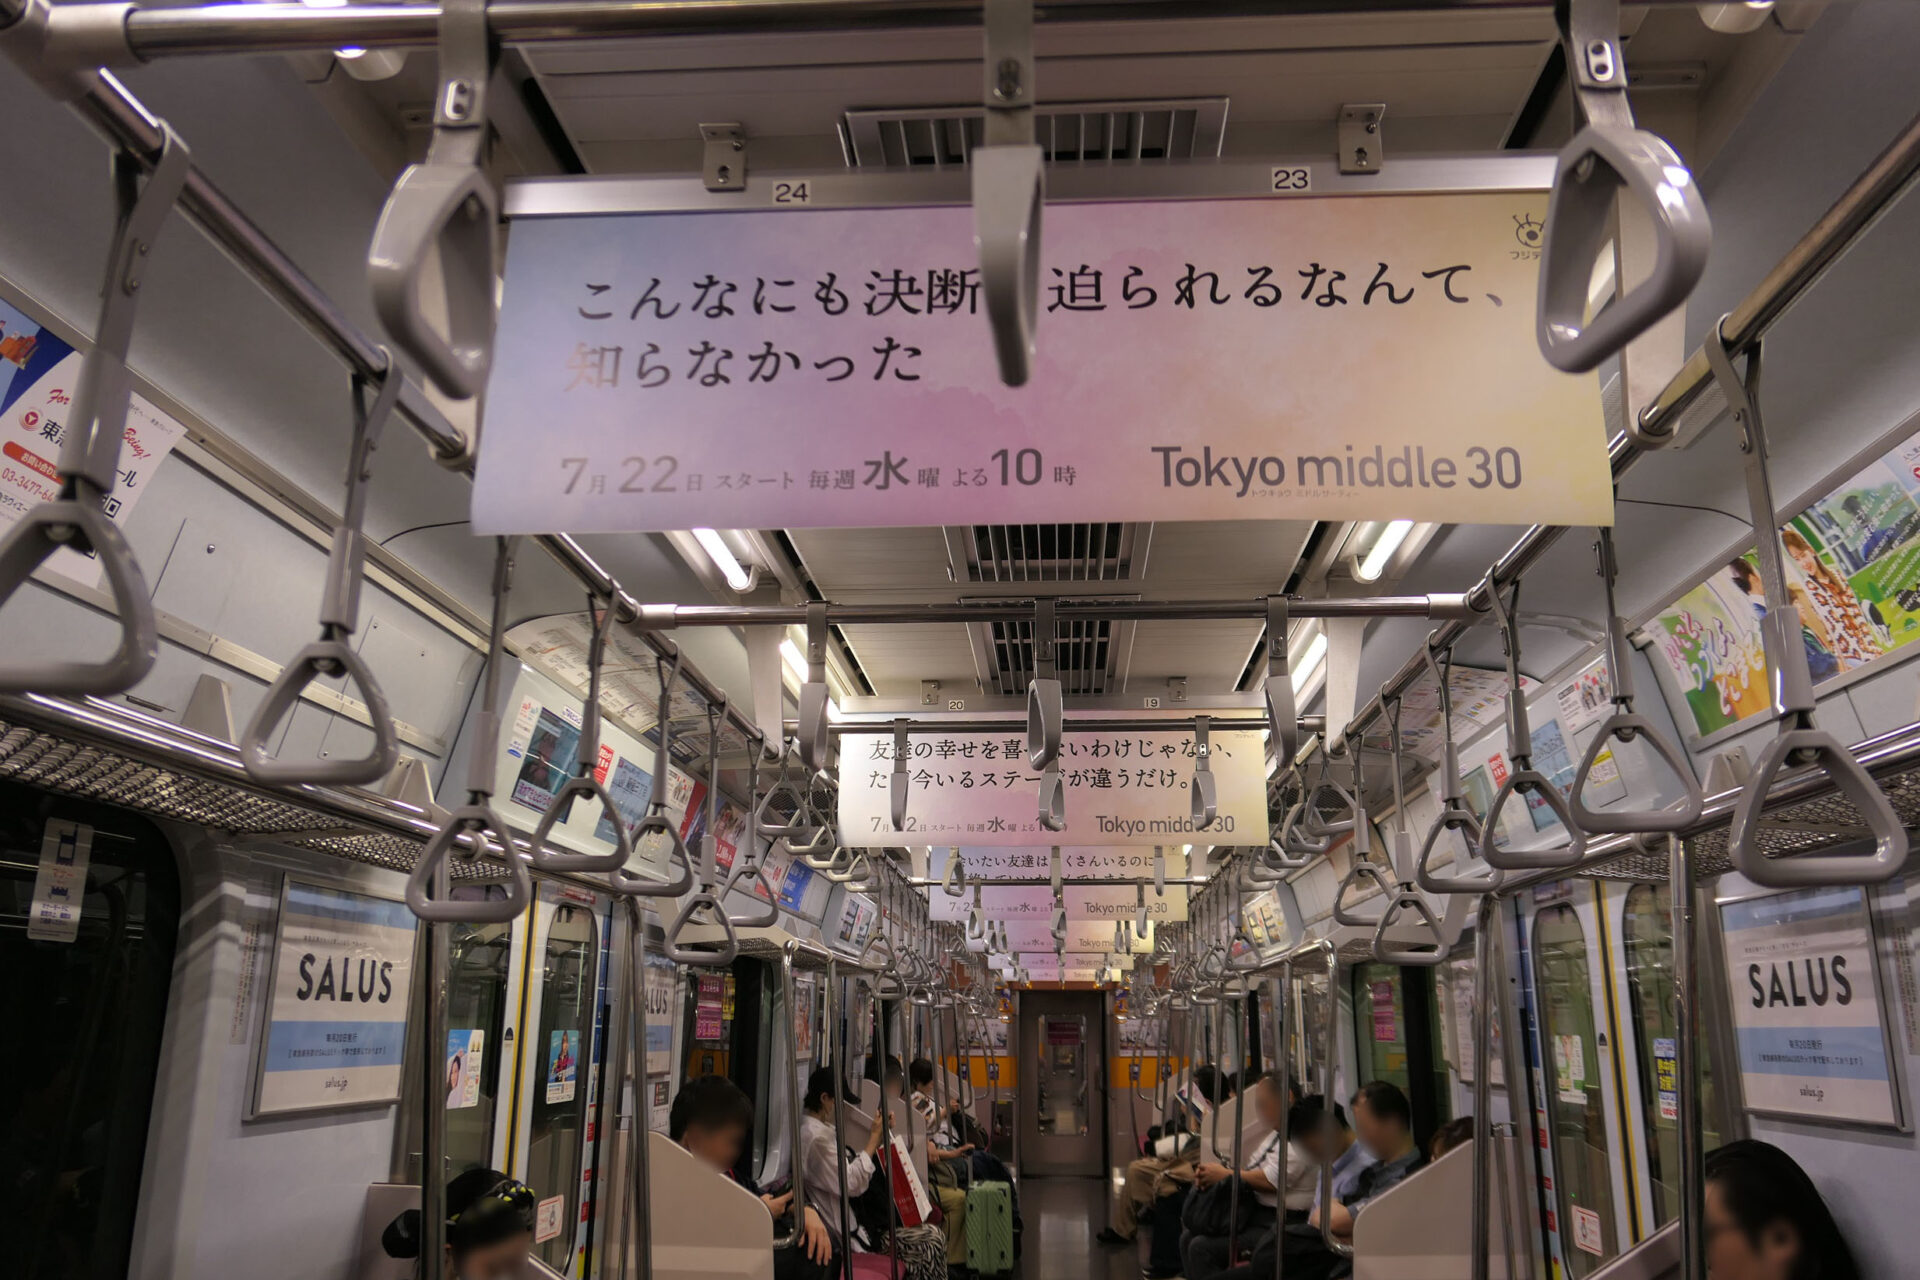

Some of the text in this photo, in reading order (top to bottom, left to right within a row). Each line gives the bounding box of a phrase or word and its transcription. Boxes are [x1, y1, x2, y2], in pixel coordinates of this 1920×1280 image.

[1274, 169, 1309, 190] 23
[775, 183, 809, 203] 24
[577, 262, 1503, 321] こんなにも決断迫られるなんて、
[565, 336, 923, 392] 知らなかった
[46, 388, 70, 405] For
[716, 470, 795, 491] スタート
[1151, 444, 1523, 498] Tokyo middle 30
[949, 702, 964, 710] 20
[1145, 699, 1159, 708] 19
[869, 738, 1233, 761] 友の幸せを喜いわけじゃない、
[869, 768, 1188, 790] た今いるステーが違うだけ。
[870, 816, 927, 832] 7月2日
[1096, 816, 1235, 837] Tokyo midd 30
[959, 854, 1154, 868] いたい友達はくさんいるのに
[1084, 902, 1168, 915] Tokyo mide 30
[297, 953, 393, 1004] SALUS
[1748, 955, 1853, 1009] SALUS
[644, 986, 668, 1016] ALUS
